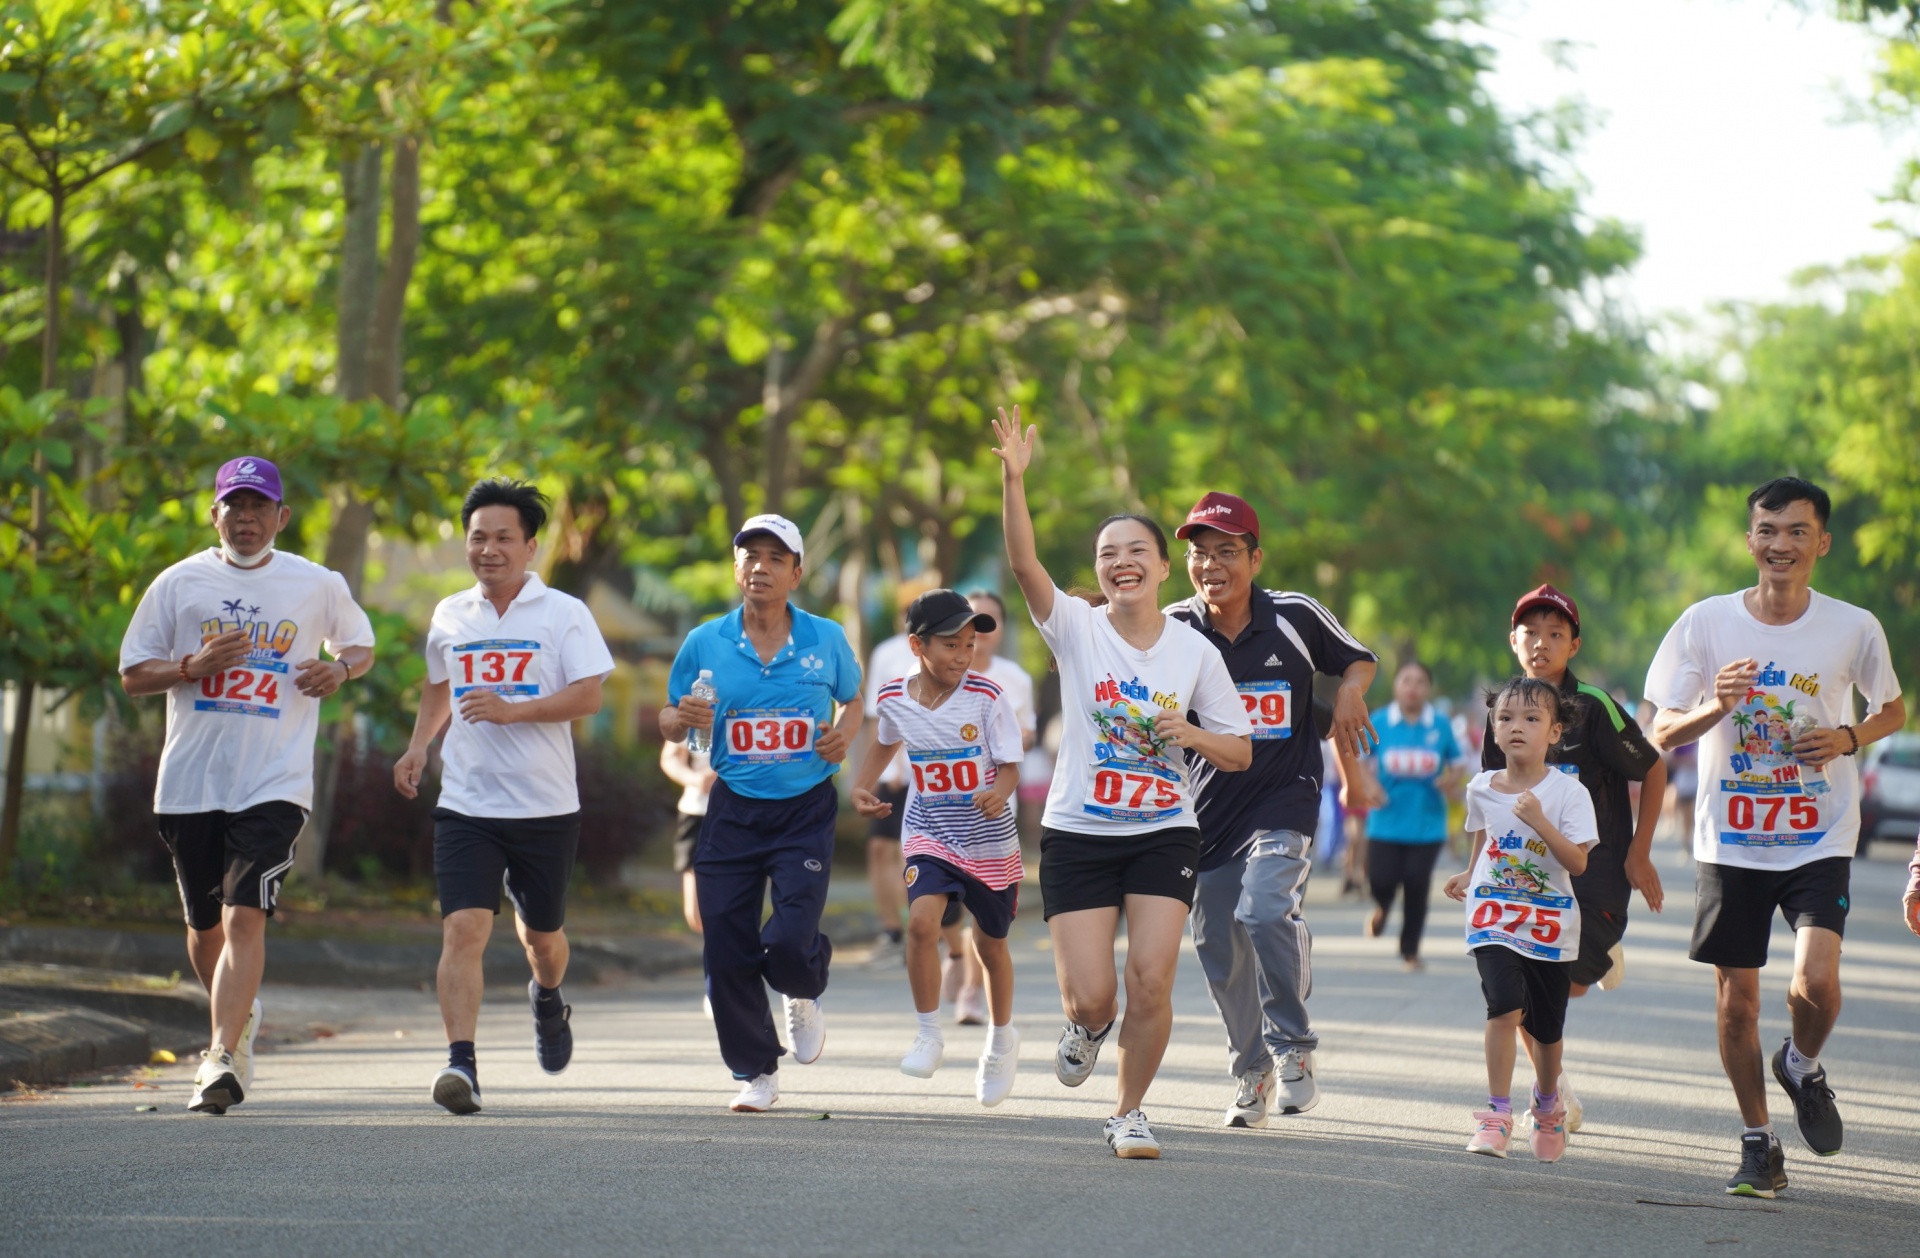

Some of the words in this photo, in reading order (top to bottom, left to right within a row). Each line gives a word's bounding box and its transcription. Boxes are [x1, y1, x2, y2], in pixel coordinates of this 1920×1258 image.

[458, 652, 533, 684] 137
[201, 668, 278, 704] 024
[1095, 673, 1121, 702] HÈ
[1119, 676, 1149, 702] ĐẾN
[1152, 691, 1180, 712] RỒI
[1789, 673, 1821, 697] RỒI
[732, 720, 808, 752] 030
[1094, 742, 1117, 760] ĐI
[1730, 752, 1752, 774] ĐI
[1094, 770, 1181, 808] 075
[1728, 795, 1819, 831] 075
[1499, 829, 1523, 850] ĐẾN
[1472, 900, 1562, 943] 075
